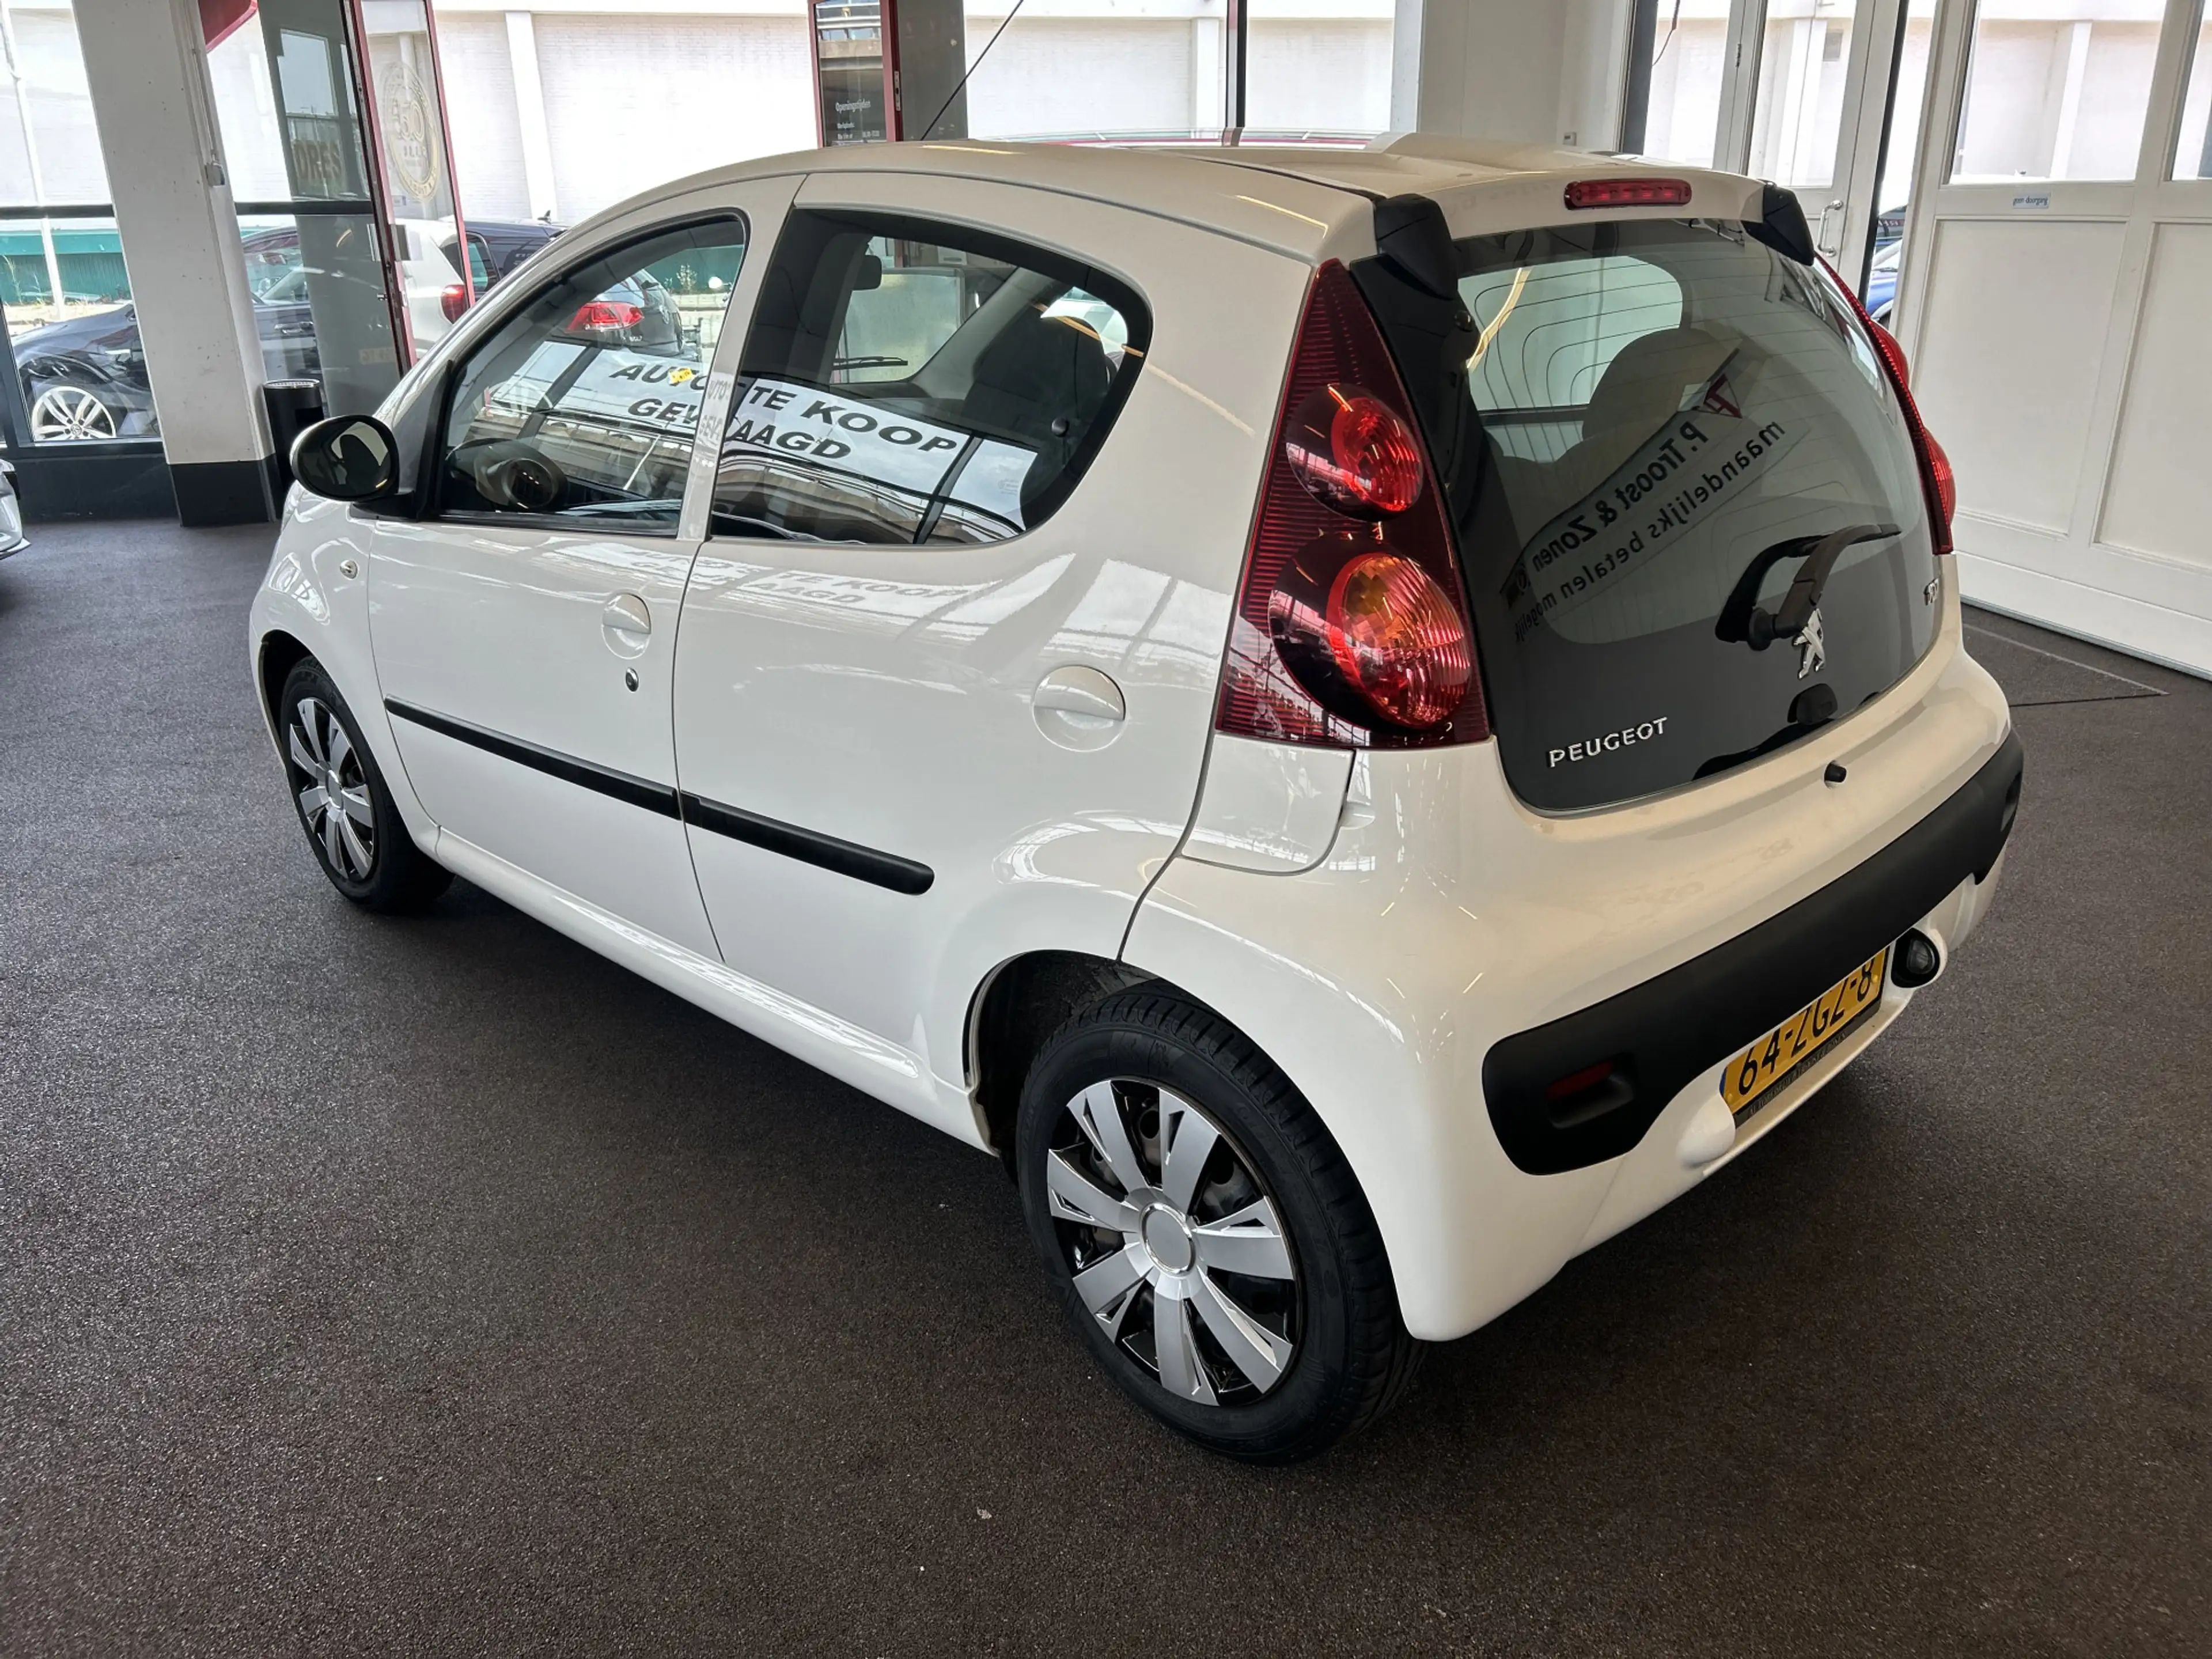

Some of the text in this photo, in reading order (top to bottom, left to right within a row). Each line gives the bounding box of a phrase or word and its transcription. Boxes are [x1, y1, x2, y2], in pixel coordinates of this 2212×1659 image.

[749, 385, 797, 411] TE
[801, 399, 957, 452] KOOP
[1546, 716, 1668, 768] PEUGEOT
